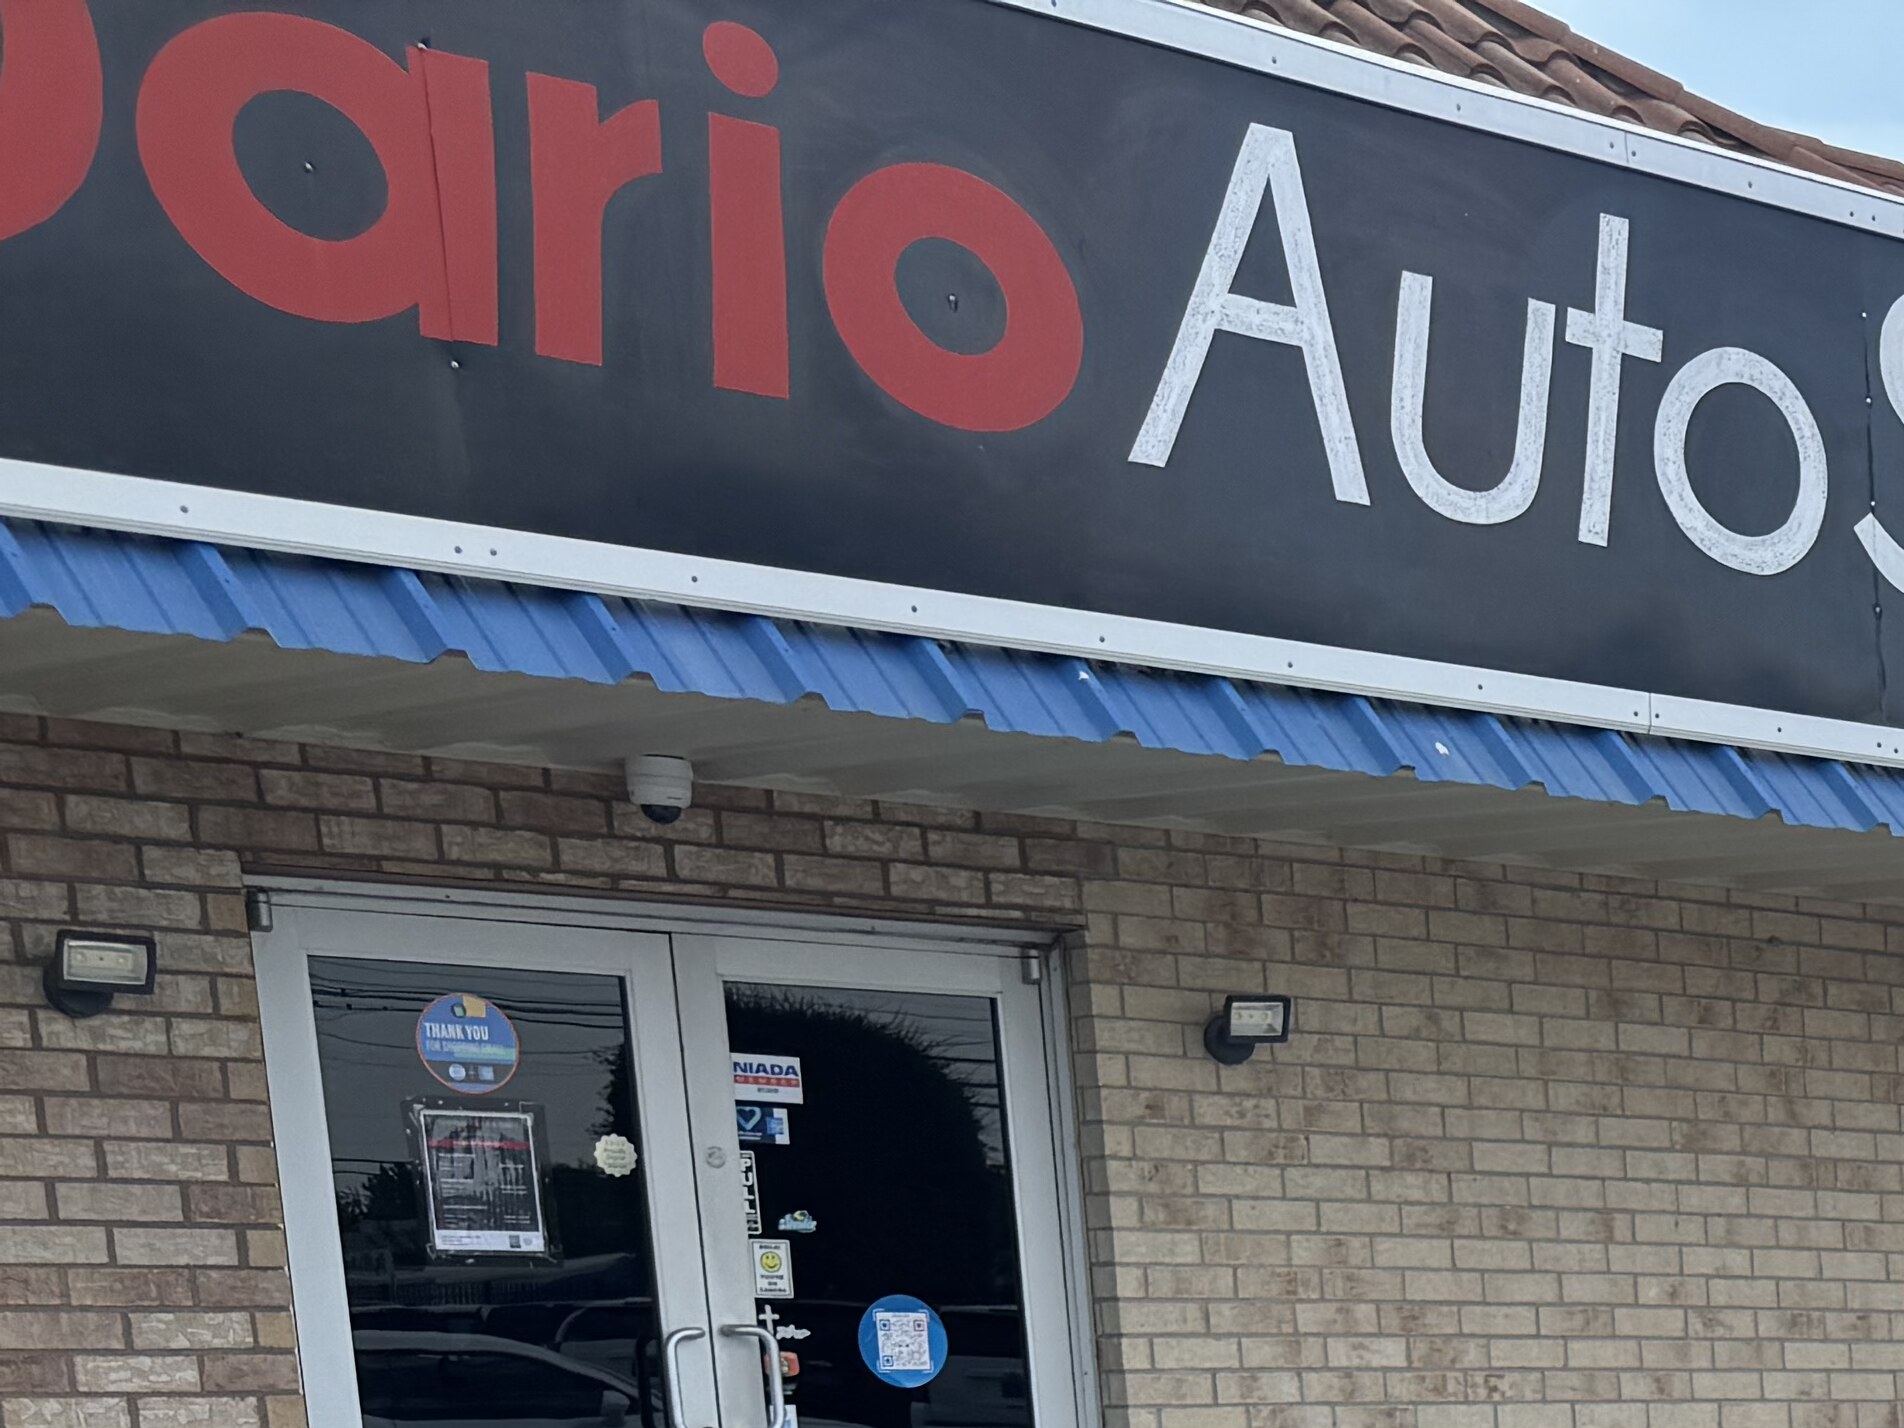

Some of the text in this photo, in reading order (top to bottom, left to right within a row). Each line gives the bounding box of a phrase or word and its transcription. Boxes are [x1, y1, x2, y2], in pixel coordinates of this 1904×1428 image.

[1128, 122, 1827, 575] Auto
[424, 1022, 488, 1041] THANK YOU
[733, 1062, 799, 1077] NIADA
